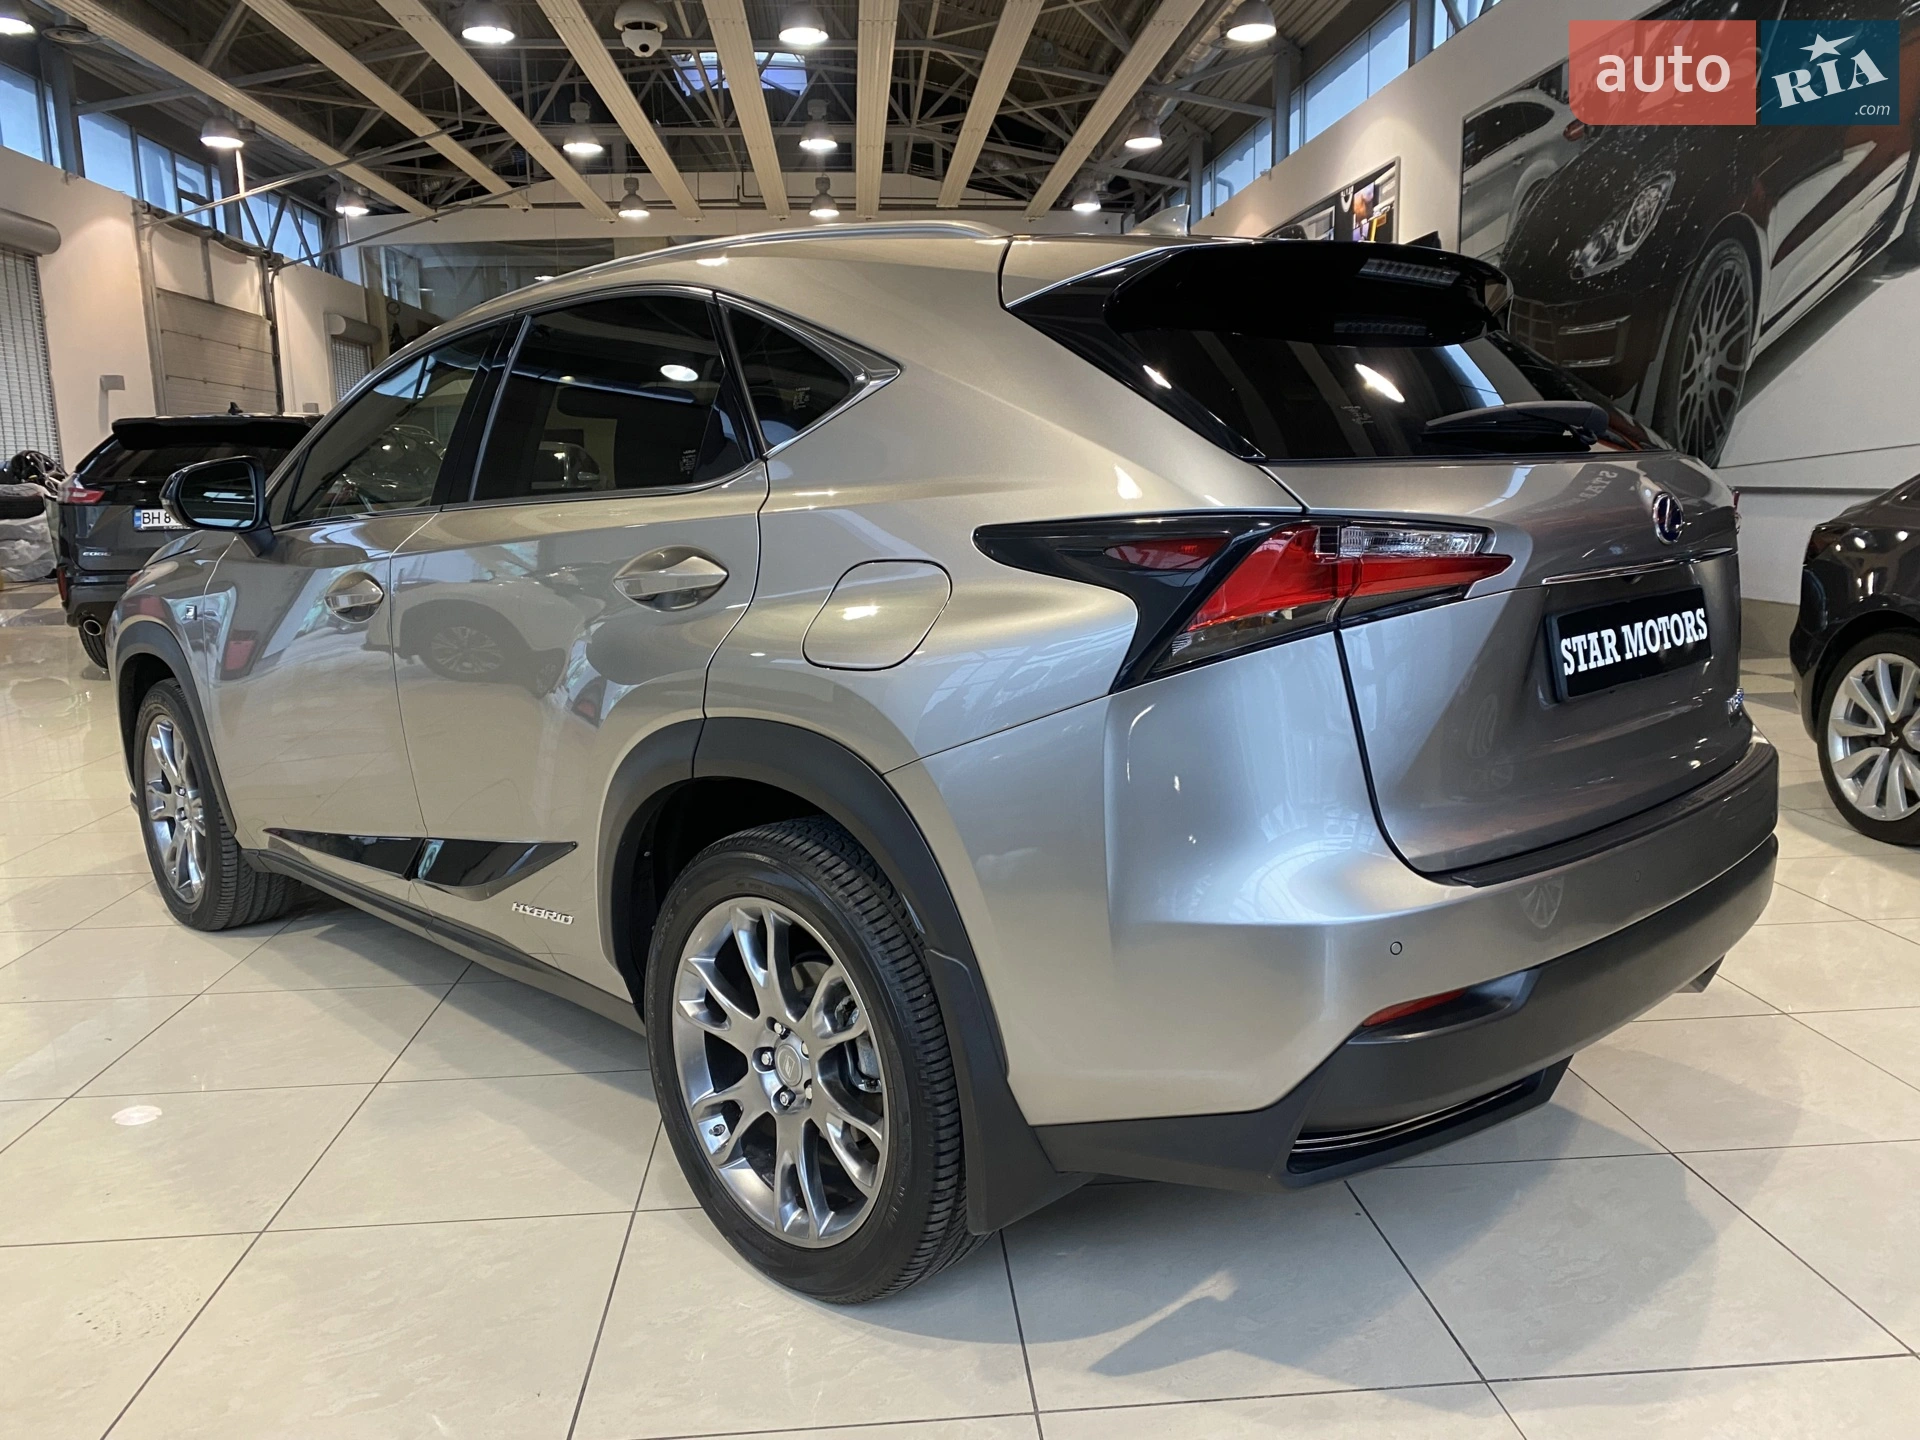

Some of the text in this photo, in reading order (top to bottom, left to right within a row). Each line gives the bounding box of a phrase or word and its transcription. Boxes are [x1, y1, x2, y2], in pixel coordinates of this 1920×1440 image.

[142, 512, 161, 525] BH
[1560, 607, 1708, 676] STAR MOTORS
[511, 902, 574, 925] HYBRID
